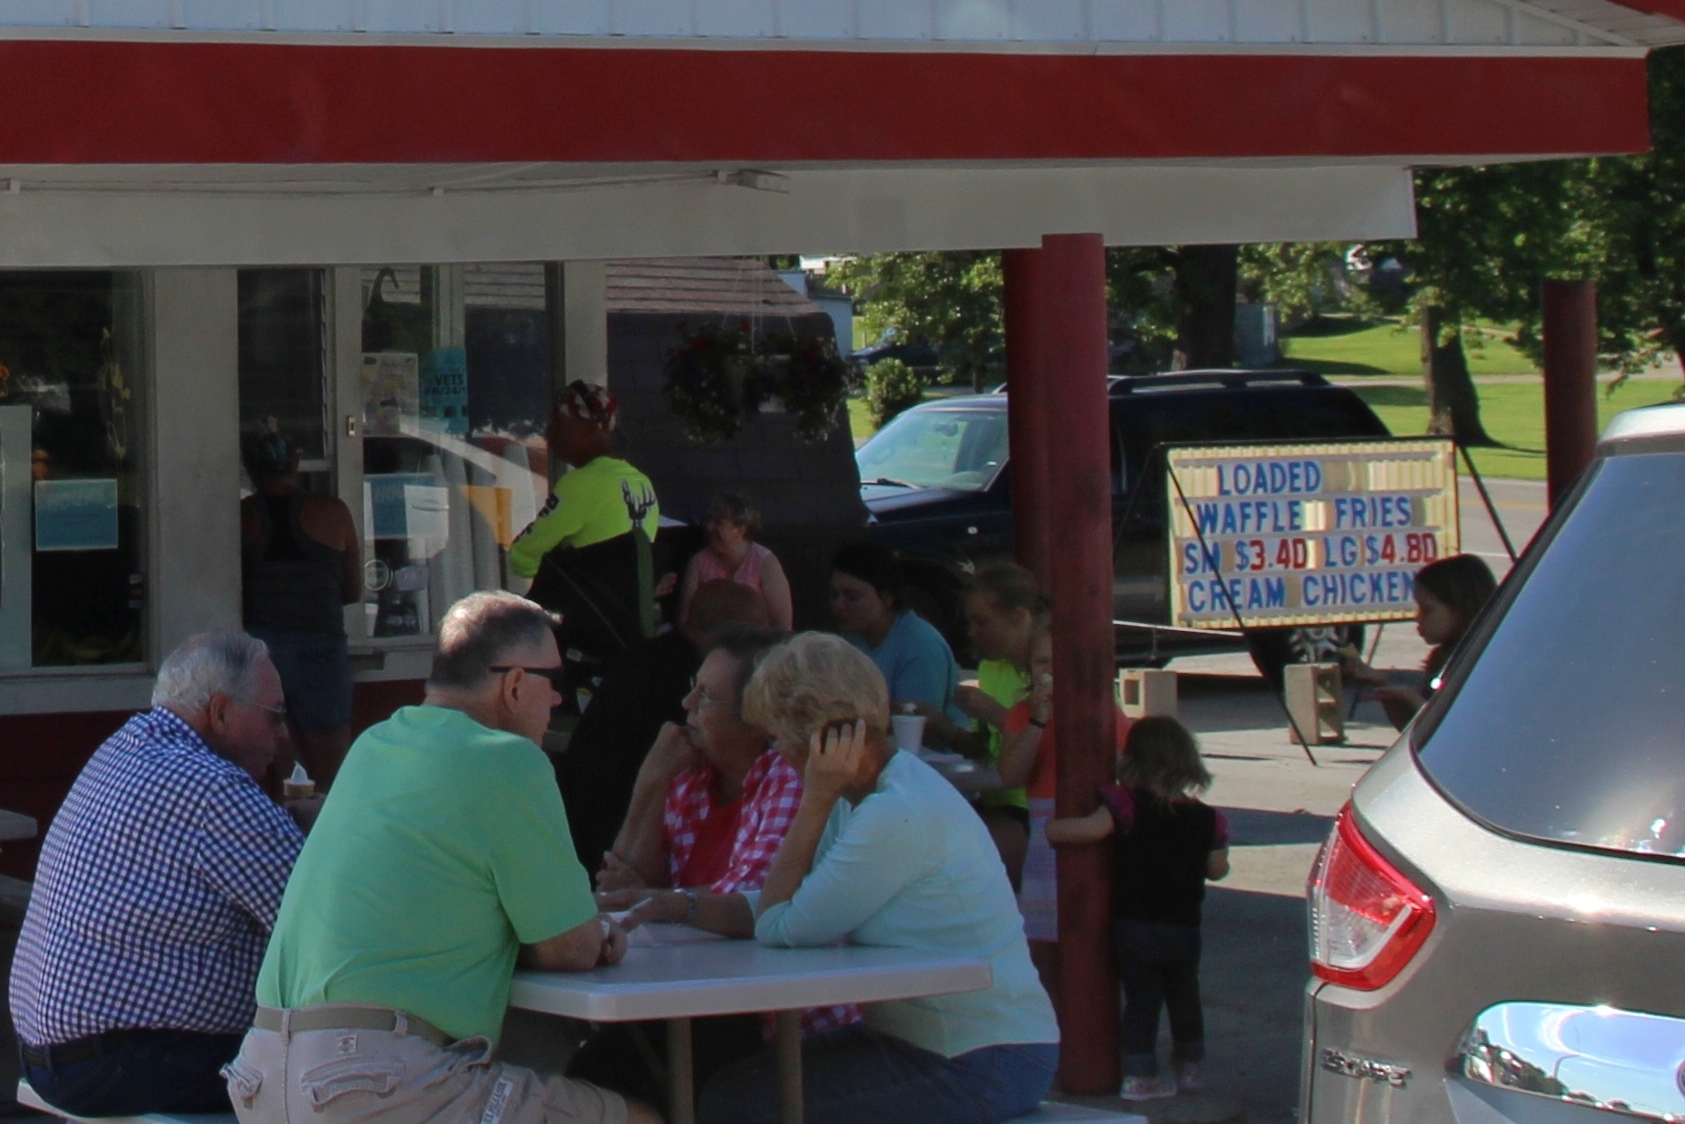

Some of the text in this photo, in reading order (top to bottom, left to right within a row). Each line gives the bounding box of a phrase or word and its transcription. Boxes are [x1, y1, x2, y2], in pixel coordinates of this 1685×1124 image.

[1217, 461, 1322, 496] LOADED
[1196, 496, 1412, 535] WAFFLE FRIES
[1184, 541, 1221, 575] SM
[1235, 537, 1308, 572] $3.40
[1323, 536, 1358, 566] LG
[1187, 571, 1416, 613] CREAM CHICKEN
